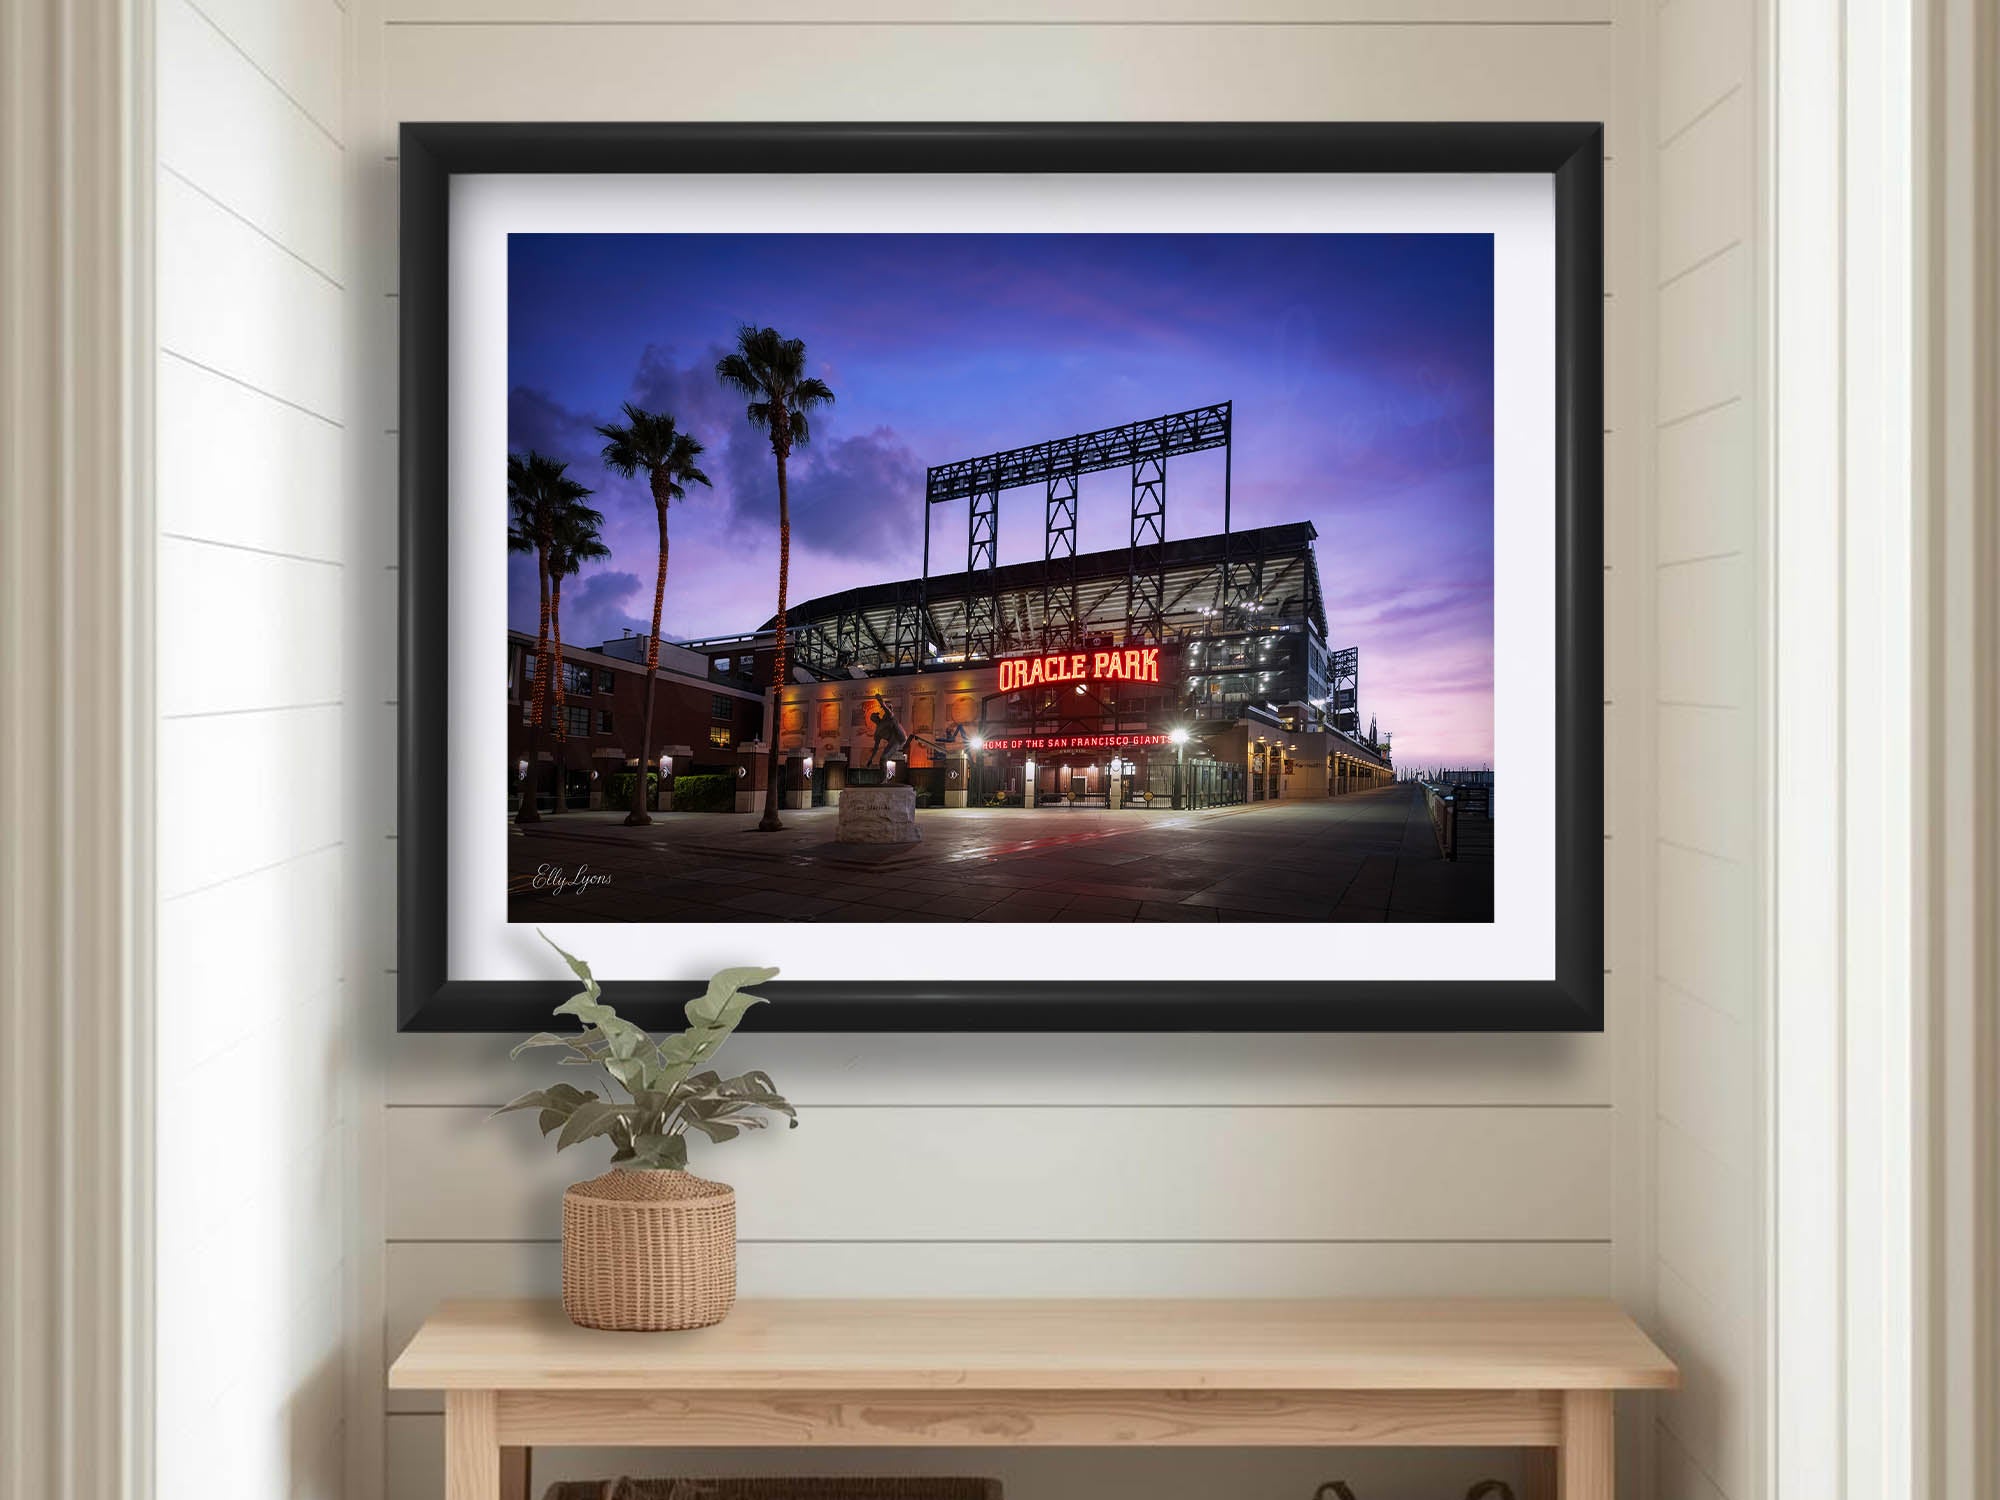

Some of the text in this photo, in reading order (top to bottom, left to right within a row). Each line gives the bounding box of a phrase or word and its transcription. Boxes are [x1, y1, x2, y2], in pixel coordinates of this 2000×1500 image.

[999, 648, 1159, 692] ORACLE PARK
[982, 735, 1173, 750] HOME OF THE SAN FRANCISCO GIANTS
